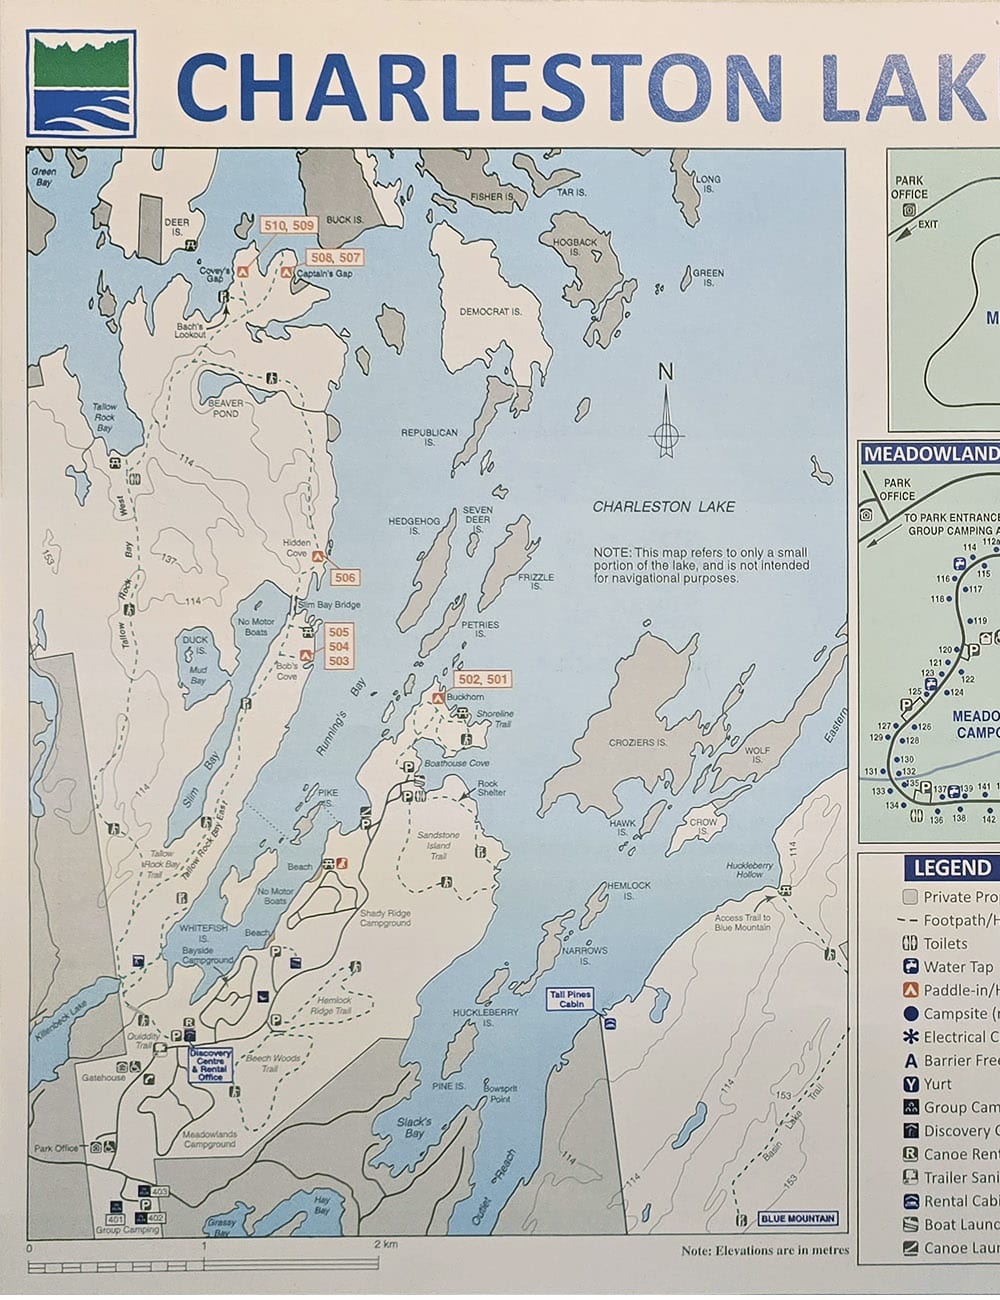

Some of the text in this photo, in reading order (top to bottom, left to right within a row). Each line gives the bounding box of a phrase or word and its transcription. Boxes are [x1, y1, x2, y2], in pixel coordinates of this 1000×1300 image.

[177, 53, 782, 123] CHARLESTON
[293, 220, 314, 231] 509
[340, 252, 361, 263] 507
[460, 307, 523, 316] DEMOCRAT IS.
[659, 362, 673, 380] N
[593, 500, 736, 513] CHARLESTON LAKE
[594, 547, 808, 559] NOTE: This map refers to only a small
[336, 574, 355, 583] 506
[329, 627, 349, 637] 505
[329, 641, 349, 651] 504
[329, 656, 349, 666] 503
[487, 674, 506, 686] 501
[609, 738, 669, 747] CROZIERS IS.
[915, 859, 991, 876] LEGEND
[924, 891, 971, 903] Private
[924, 937, 967, 950] Toilets
[924, 1007, 987, 1023] Campsite
[924, 1078, 952, 1090] Yurt
[925, 1125, 991, 1139] Discovery
[762, 1215, 785, 1223] BLUE
[682, 1246, 711, 1256] Note:
[716, 1245, 773, 1256] Elevations
[798, 1245, 808, 1255] in
[812, 1246, 849, 1255] metres
